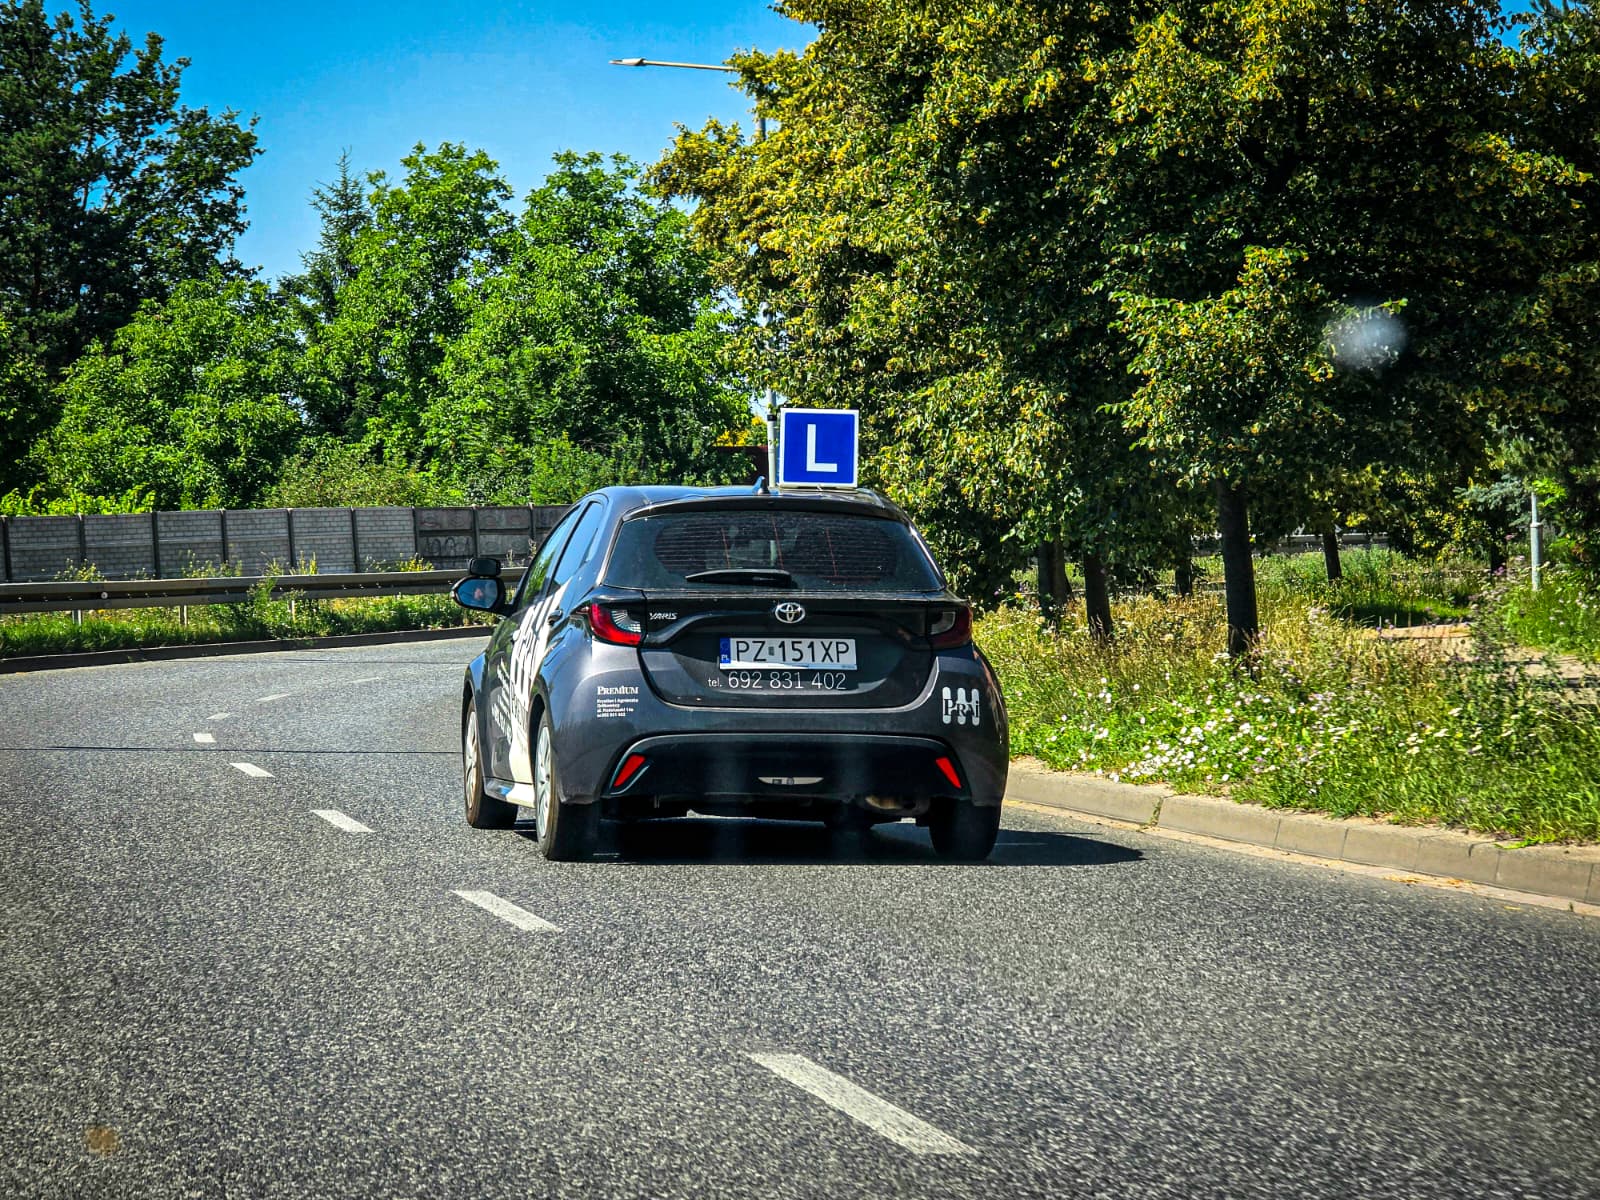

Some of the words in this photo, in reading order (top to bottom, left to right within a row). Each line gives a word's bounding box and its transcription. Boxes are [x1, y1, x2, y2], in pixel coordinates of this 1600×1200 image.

[806, 423, 837, 472] L
[649, 612, 678, 620] YARIS
[736, 641, 767, 662] PZ
[778, 641, 849, 662] 151XP
[708, 677, 722, 687] tel.
[728, 671, 762, 689] 692
[769, 671, 804, 689] 831
[811, 672, 847, 690] 402
